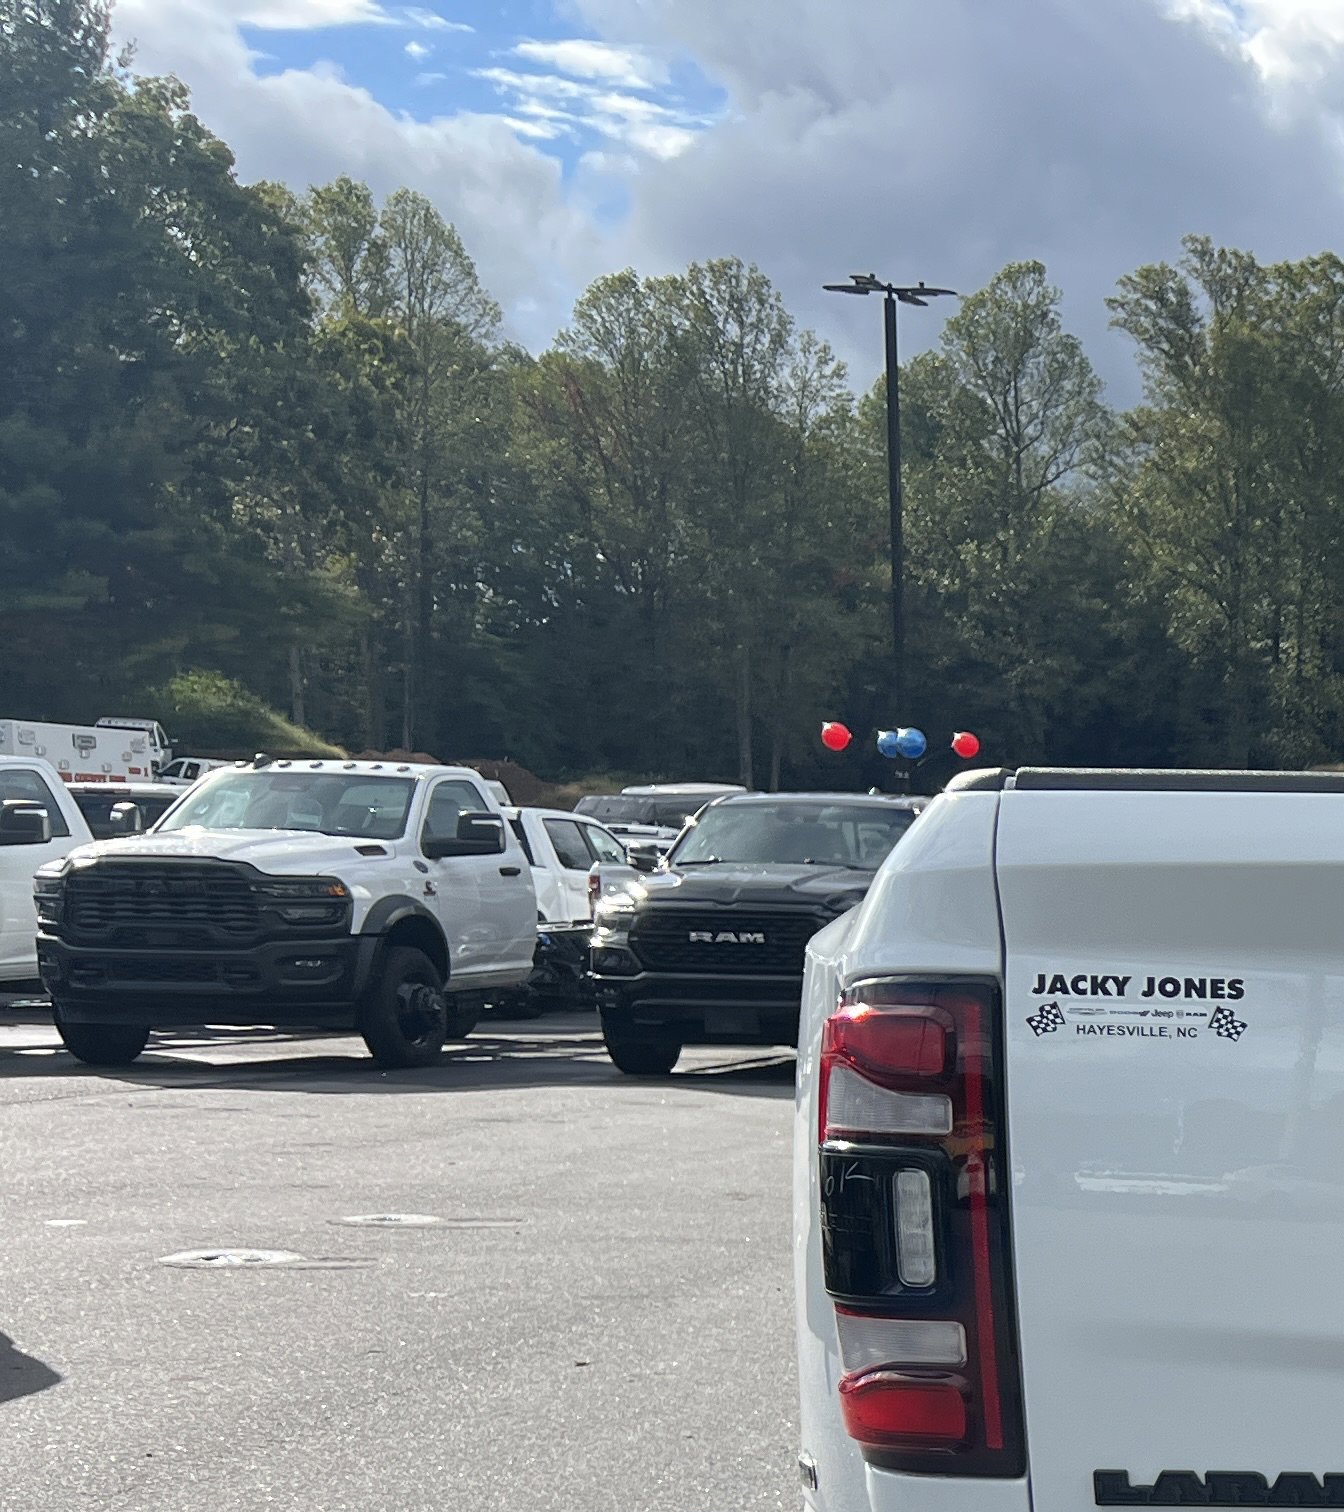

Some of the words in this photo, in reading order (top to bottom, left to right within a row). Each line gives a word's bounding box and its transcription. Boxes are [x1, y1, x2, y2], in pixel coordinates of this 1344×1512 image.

[689, 931, 766, 944] RAM
[1031, 973, 1133, 997] JACKY
[1140, 976, 1246, 1000] JONES
[1150, 1009, 1175, 1019] Jeep
[1076, 1024, 1173, 1041] HAYESVILLE,
[1176, 1026, 1199, 1039] NC
